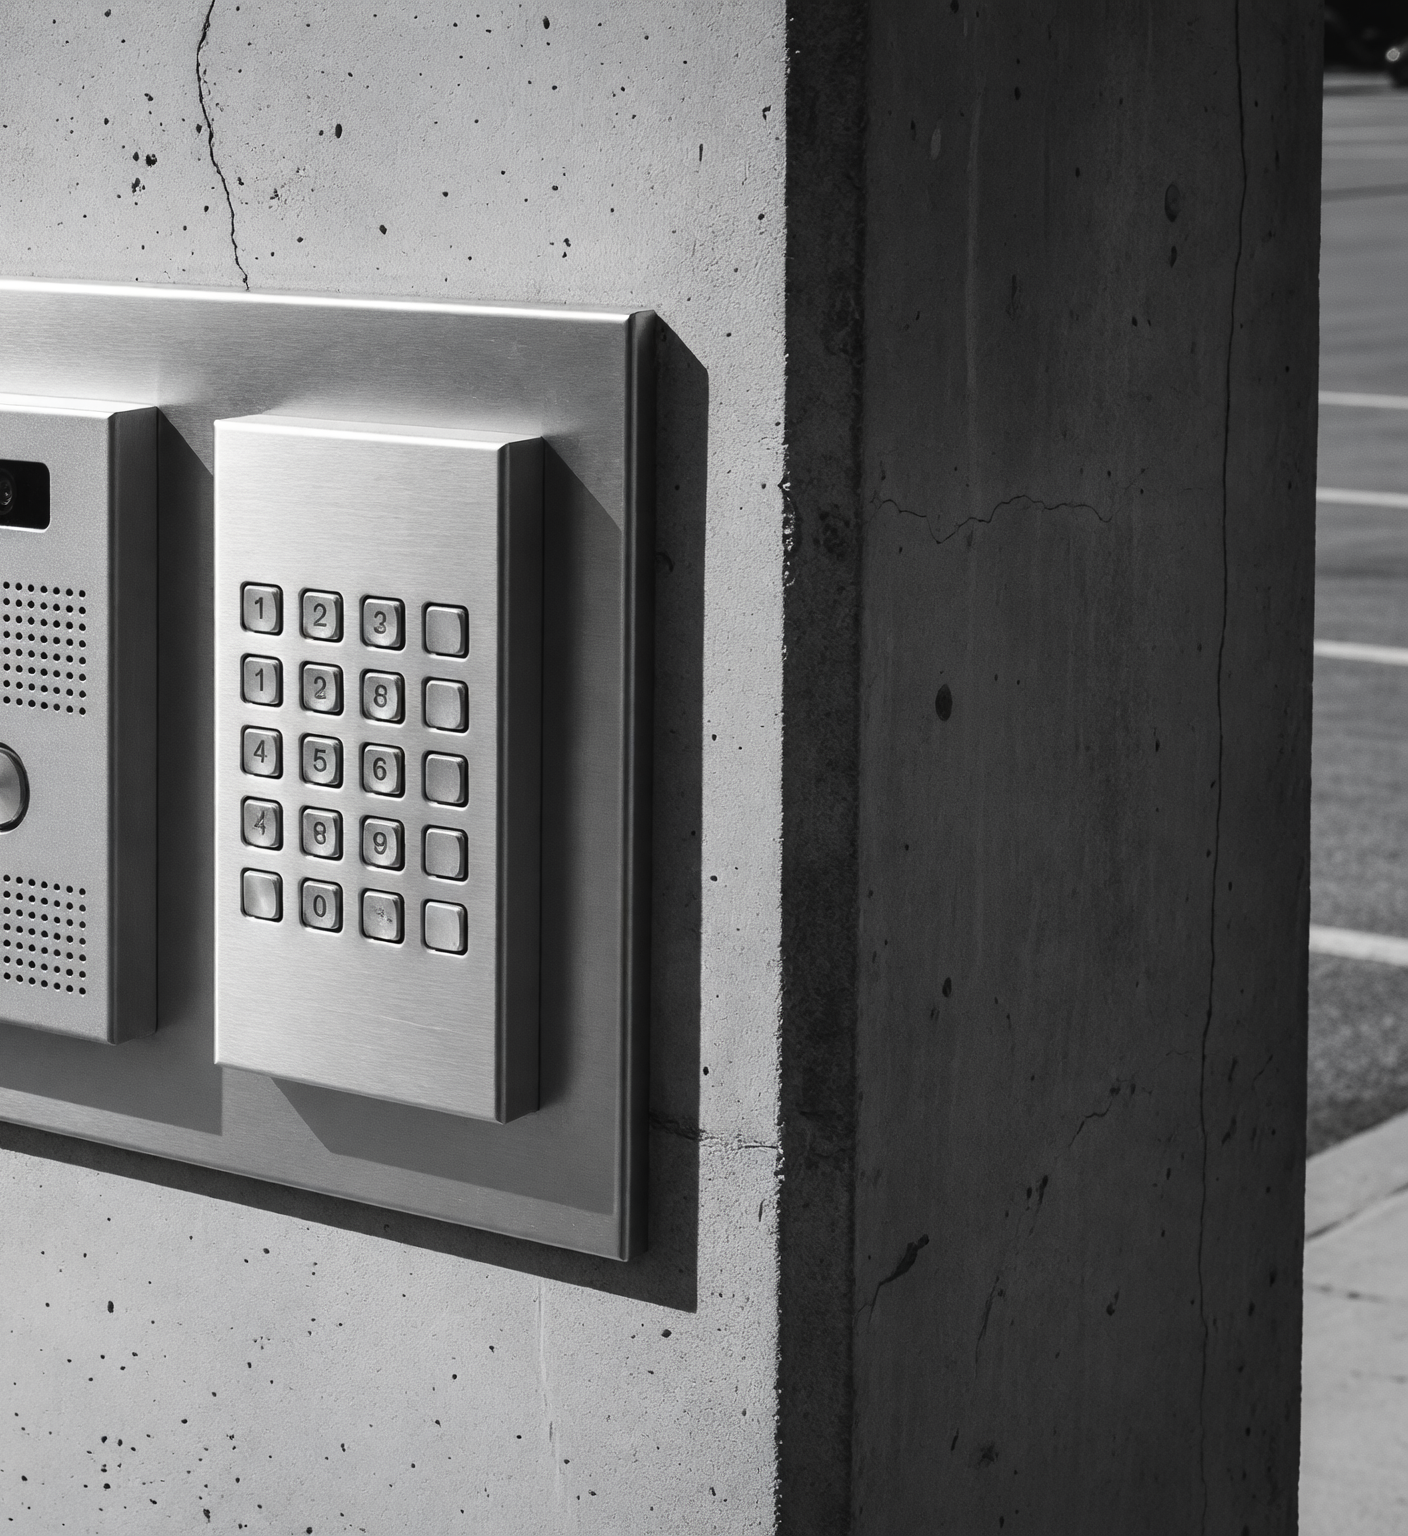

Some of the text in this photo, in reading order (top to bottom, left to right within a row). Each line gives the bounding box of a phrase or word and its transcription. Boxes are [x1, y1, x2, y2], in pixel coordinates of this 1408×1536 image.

[254, 596, 387, 634] 1 2 3
[254, 668, 388, 708] 1 2 8
[253, 739, 387, 781] 4 5 6
[313, 821, 327, 845] 8
[373, 831, 387, 855] 9
[313, 894, 327, 918] 0
